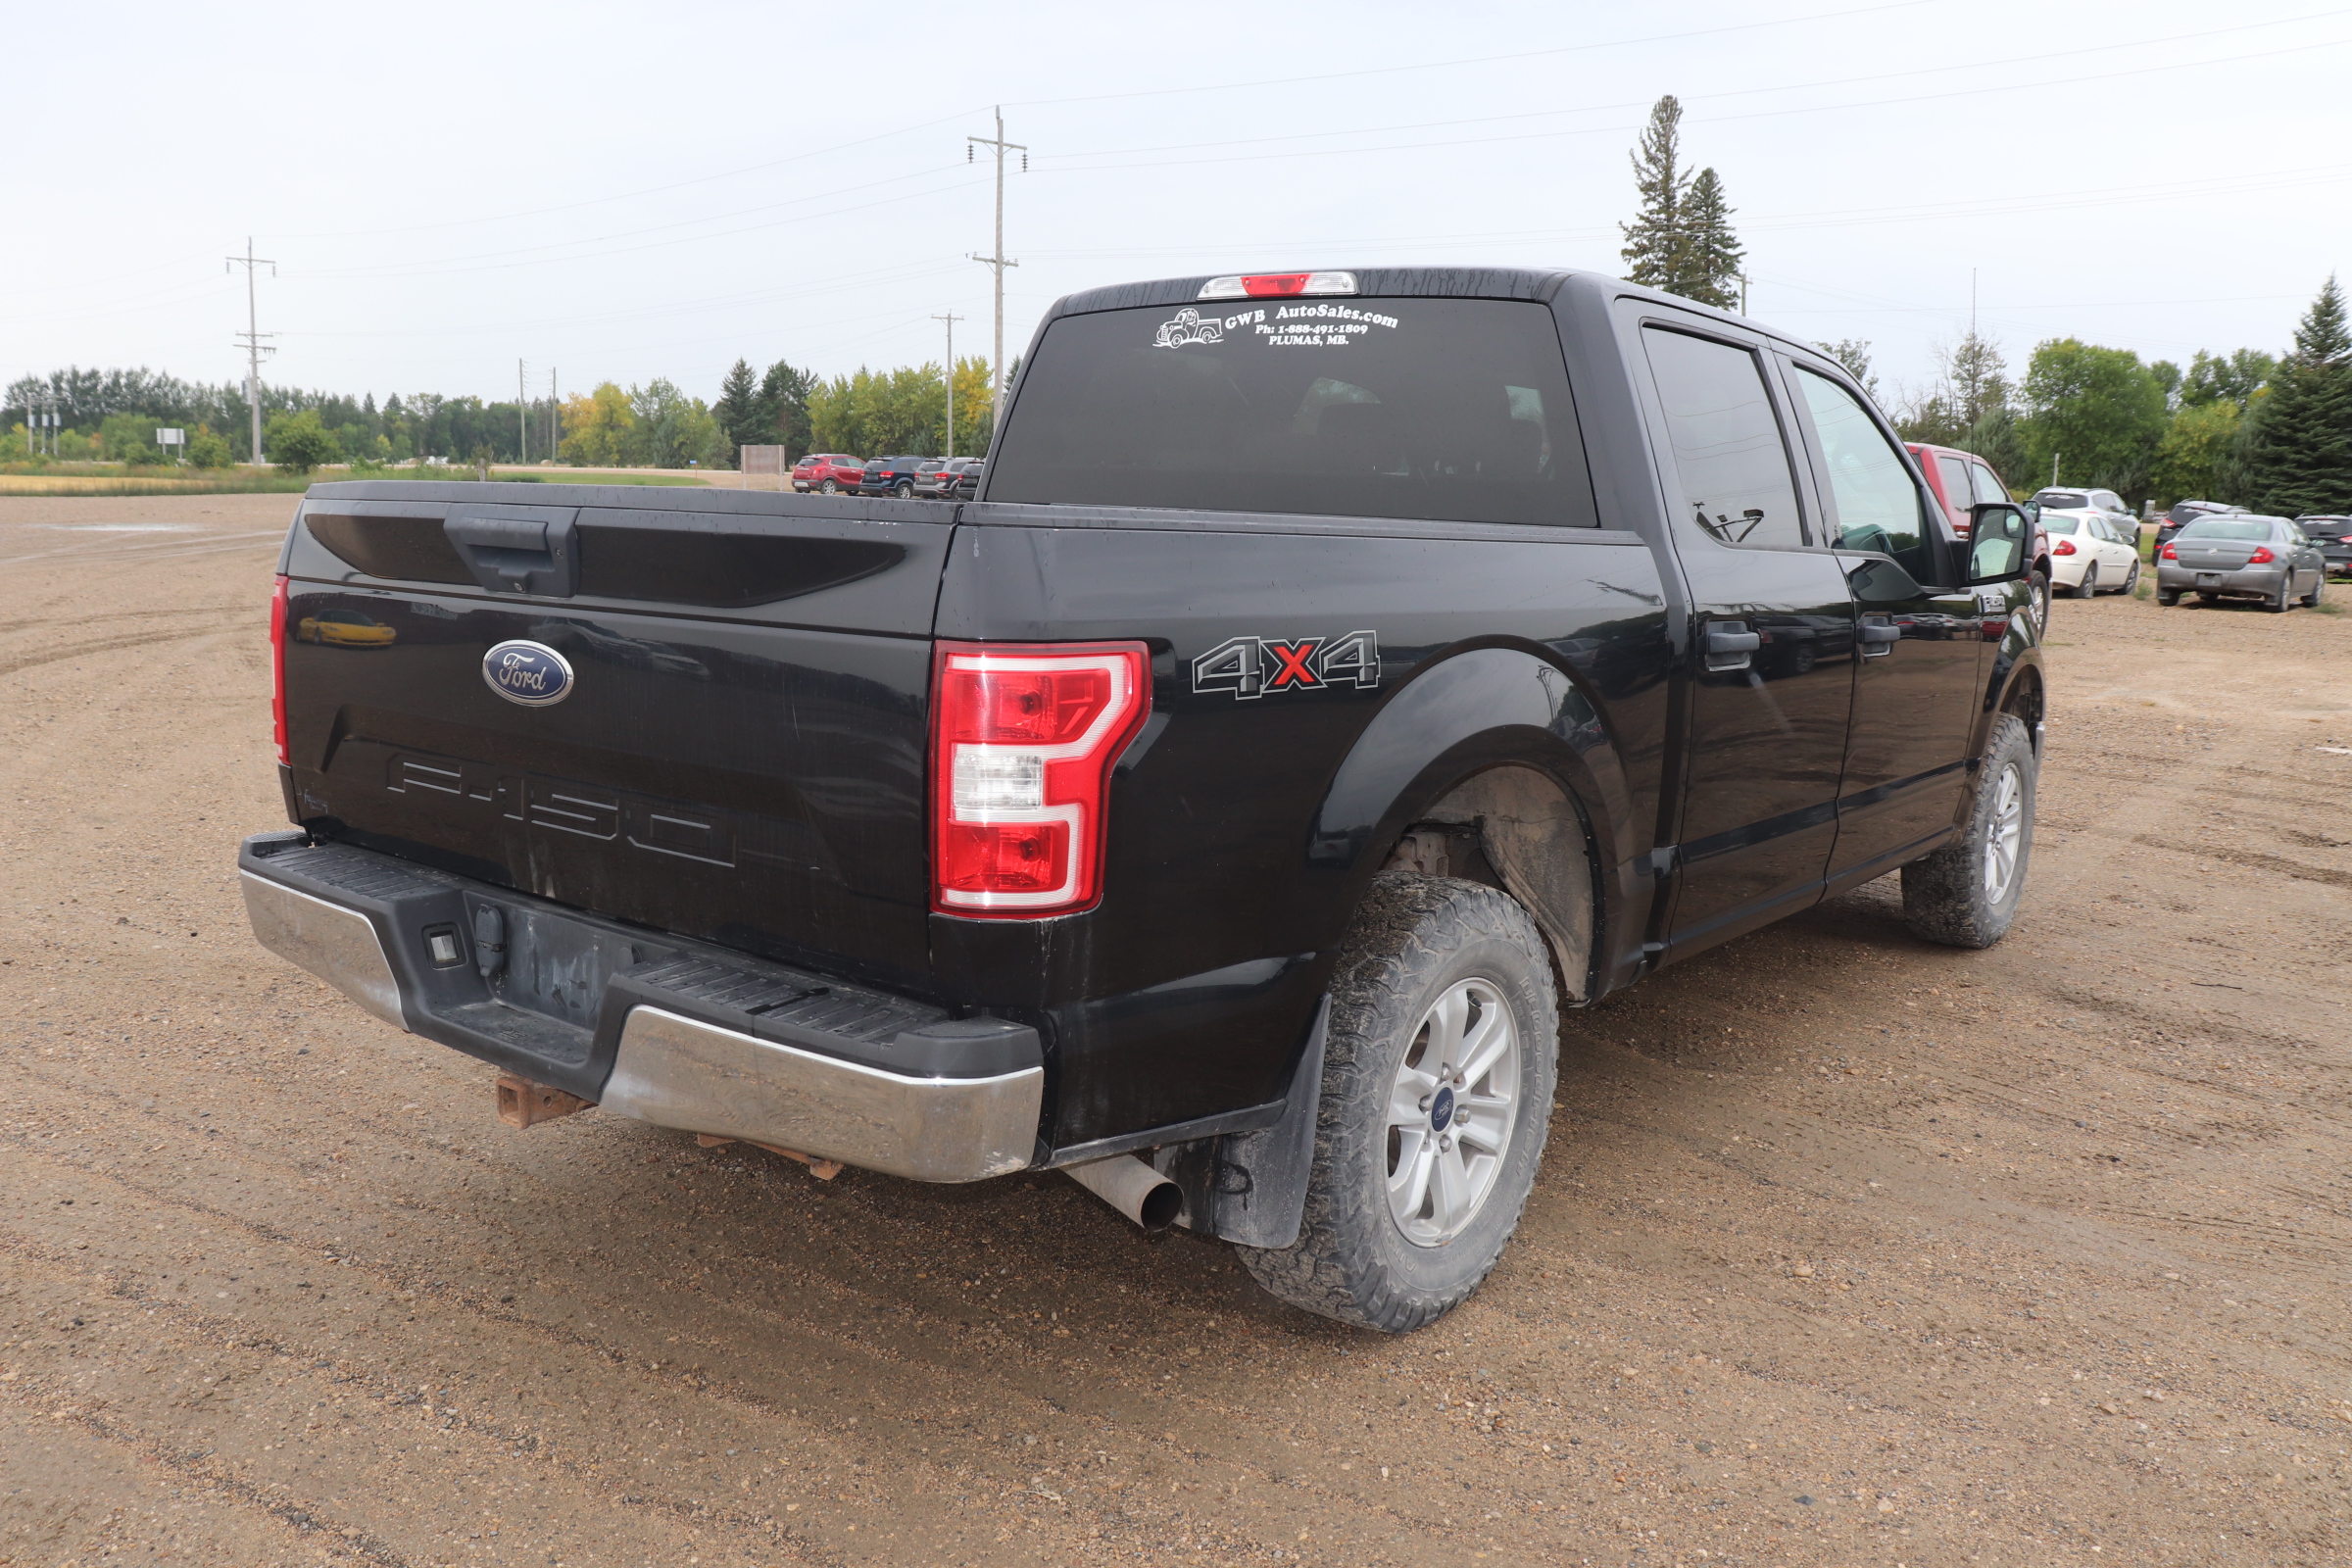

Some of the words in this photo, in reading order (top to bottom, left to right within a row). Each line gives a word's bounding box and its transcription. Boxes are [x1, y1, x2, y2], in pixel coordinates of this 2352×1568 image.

[1224, 309, 1266, 330] GWB
[1275, 304, 1398, 329] AutoSales.com
[1254, 324, 1276, 335] Ph:
[1277, 323, 1369, 335] 1-888-491-1809
[1268, 334, 1324, 348] PLUMAS,
[1325, 334, 1349, 346] MB.
[498, 652, 548, 691] Ford
